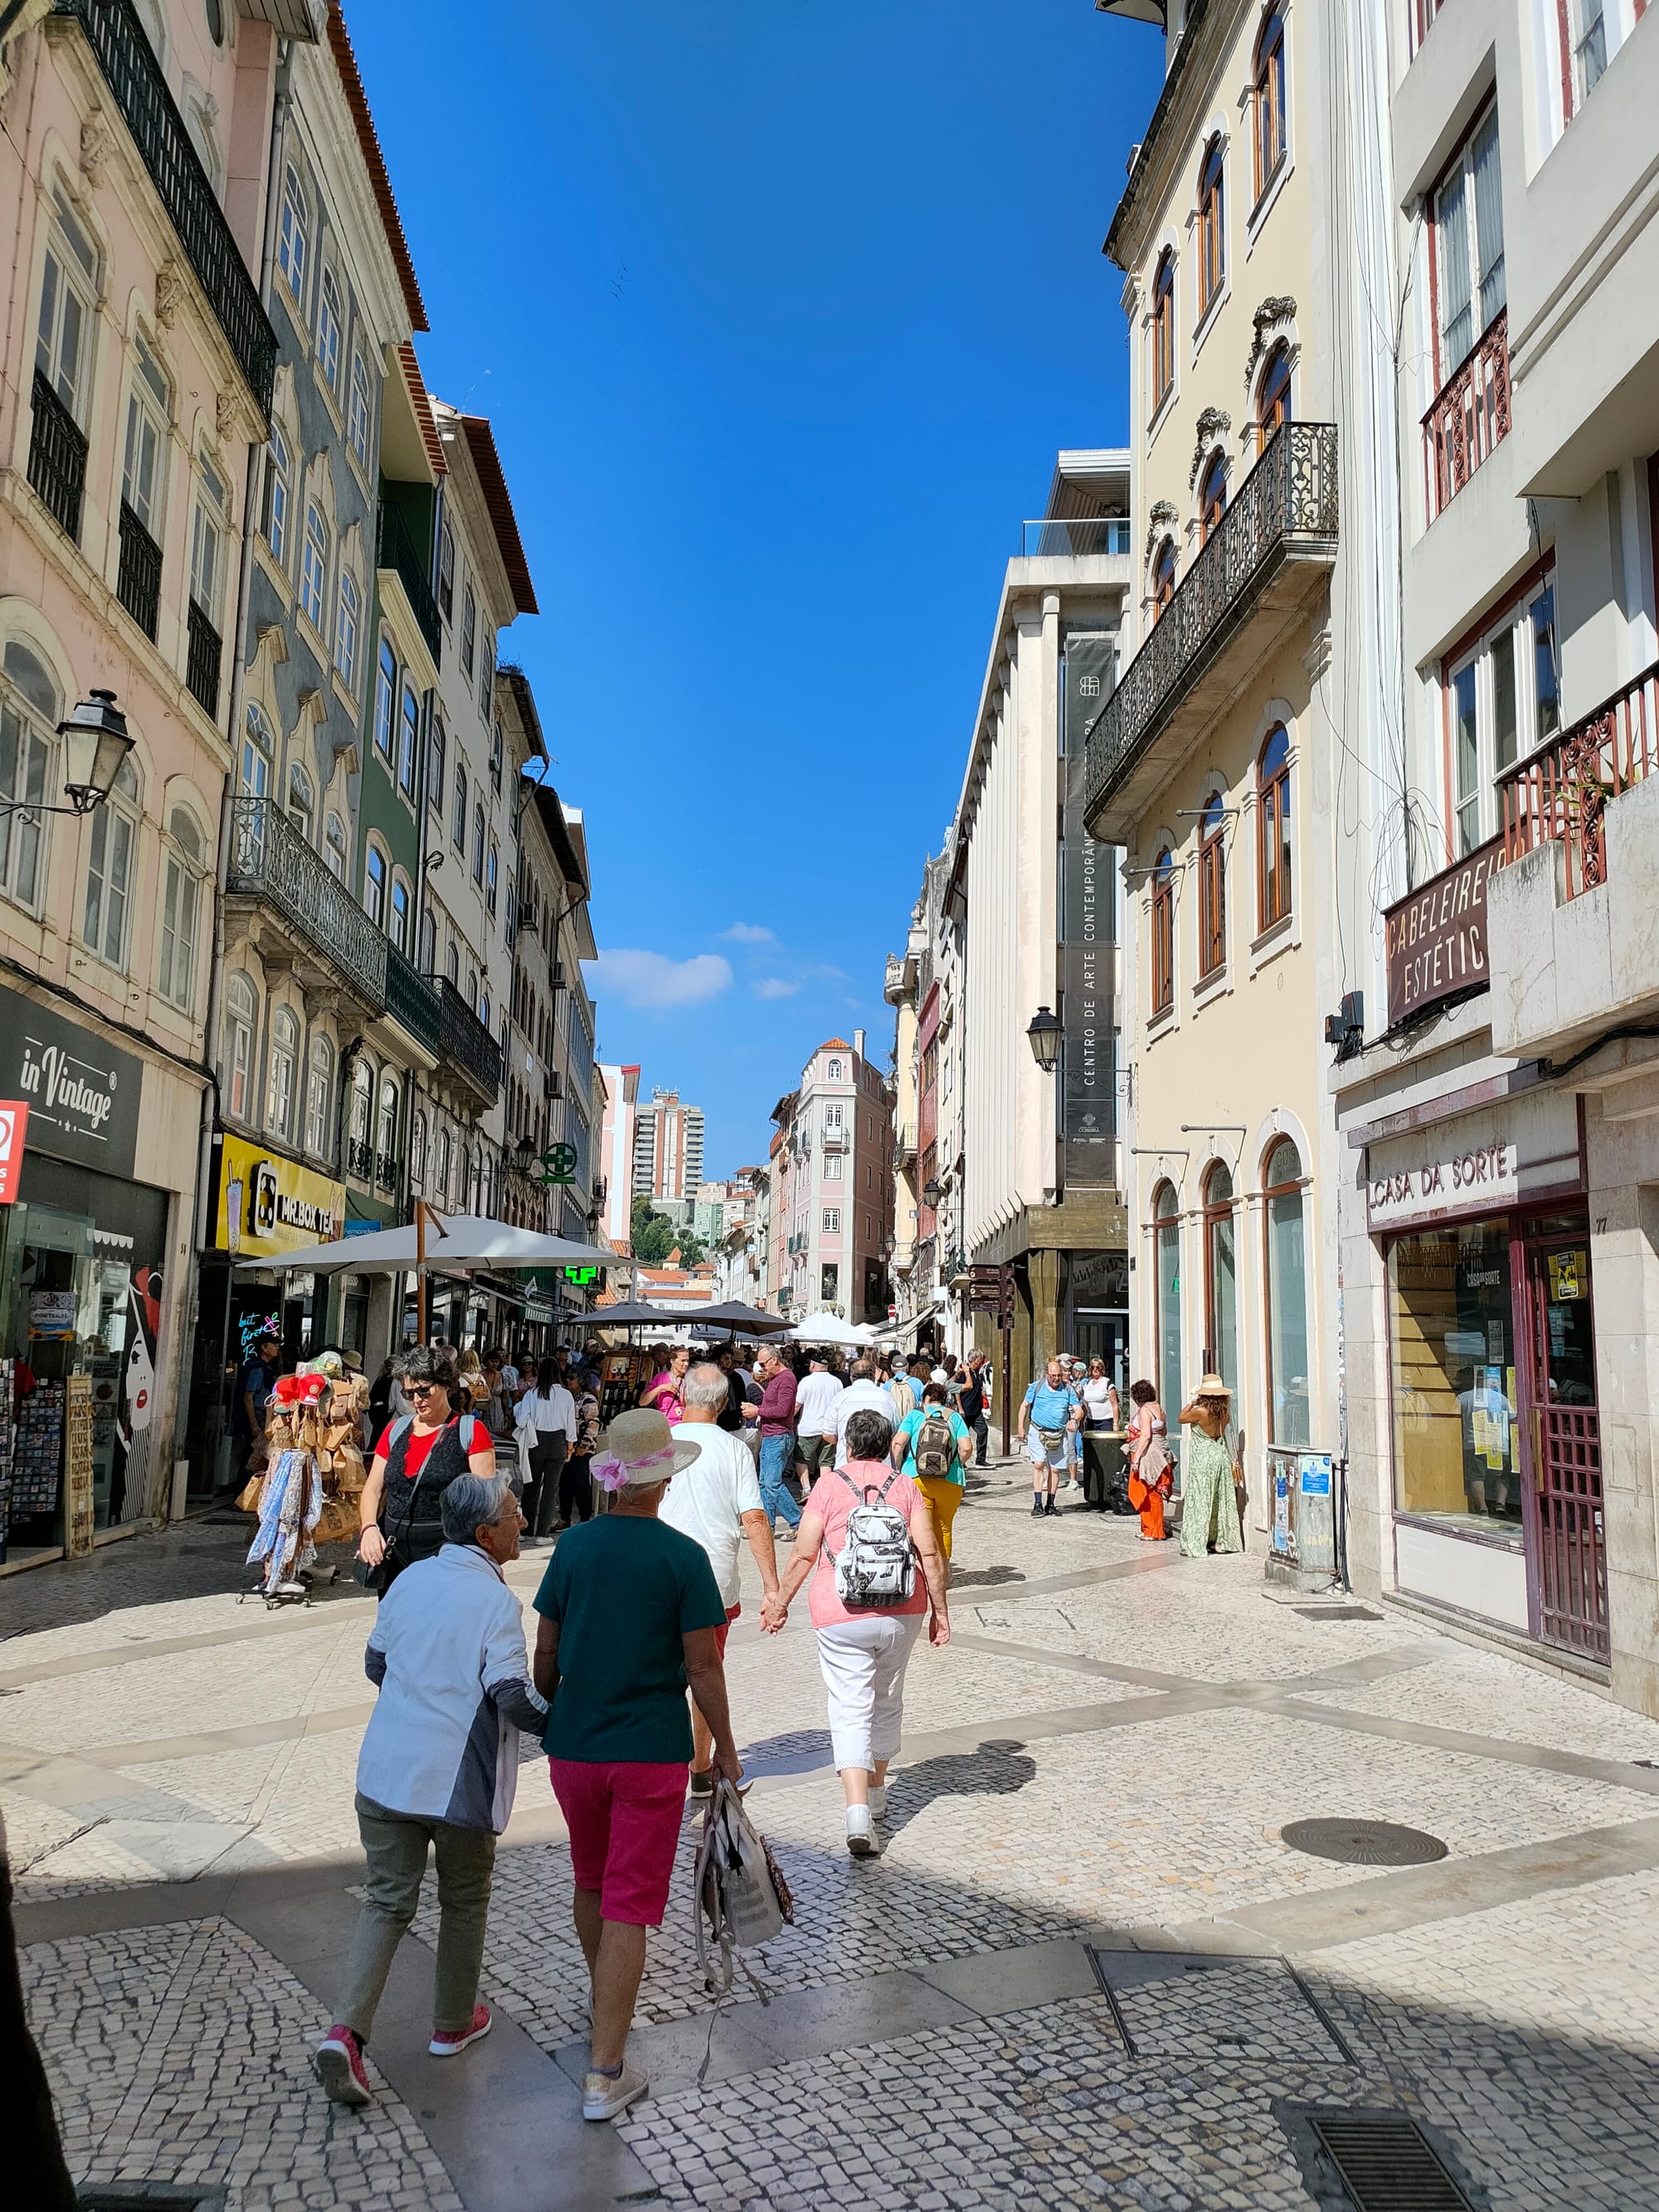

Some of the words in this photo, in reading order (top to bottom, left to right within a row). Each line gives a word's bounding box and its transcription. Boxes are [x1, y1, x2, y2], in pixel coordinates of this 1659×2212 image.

[1083, 951, 1096, 989] ARTE
[1404, 925, 1484, 1004] ESTÉTIC
[1083, 999, 1096, 1018] DE
[1083, 1028, 1096, 1086] CENTRO
[20, 1048, 40, 1093] in
[41, 1046, 111, 1129] Vintage
[1374, 1169, 1414, 1208] CASA
[1421, 1161, 1445, 1198] DA
[1452, 1141, 1508, 1190] SORTE
[318, 1208, 333, 1236] TEA
